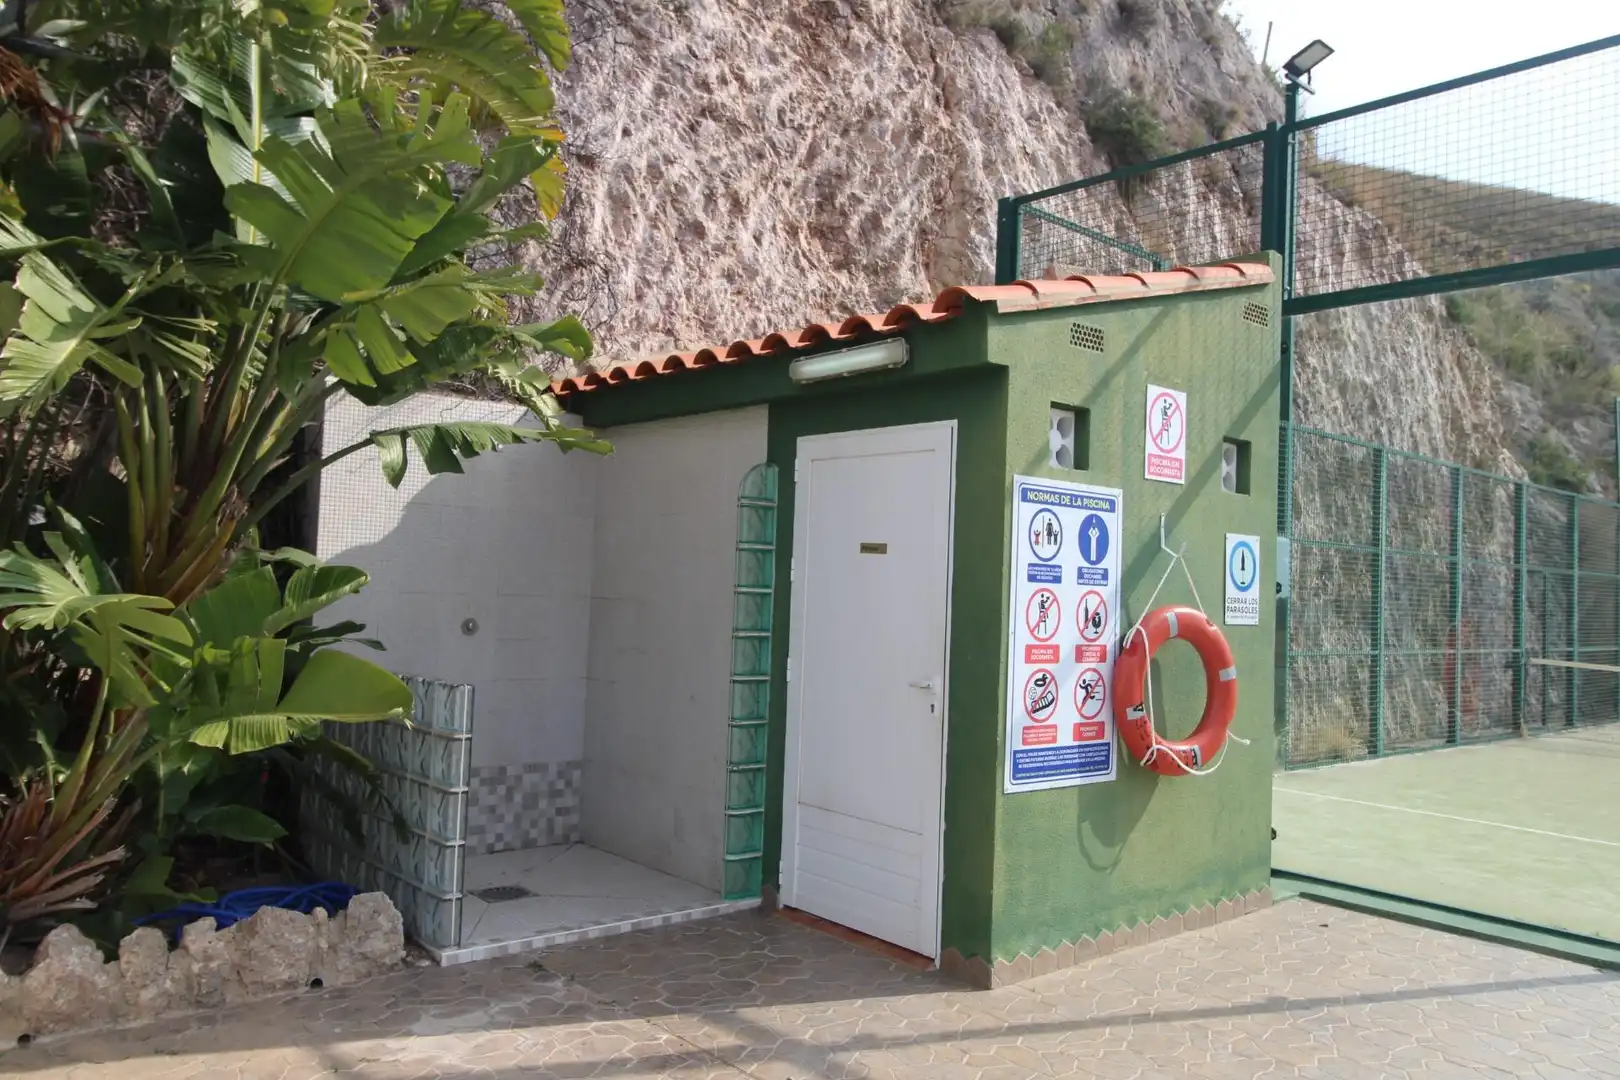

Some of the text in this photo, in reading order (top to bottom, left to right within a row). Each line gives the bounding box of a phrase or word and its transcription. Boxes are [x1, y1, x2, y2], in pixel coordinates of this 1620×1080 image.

[1027, 490, 1110, 510] NORMAS DE LA PISCINA
[1227, 597, 1247, 605] CERRAR
[1227, 605, 1258, 614] PARASOLES
